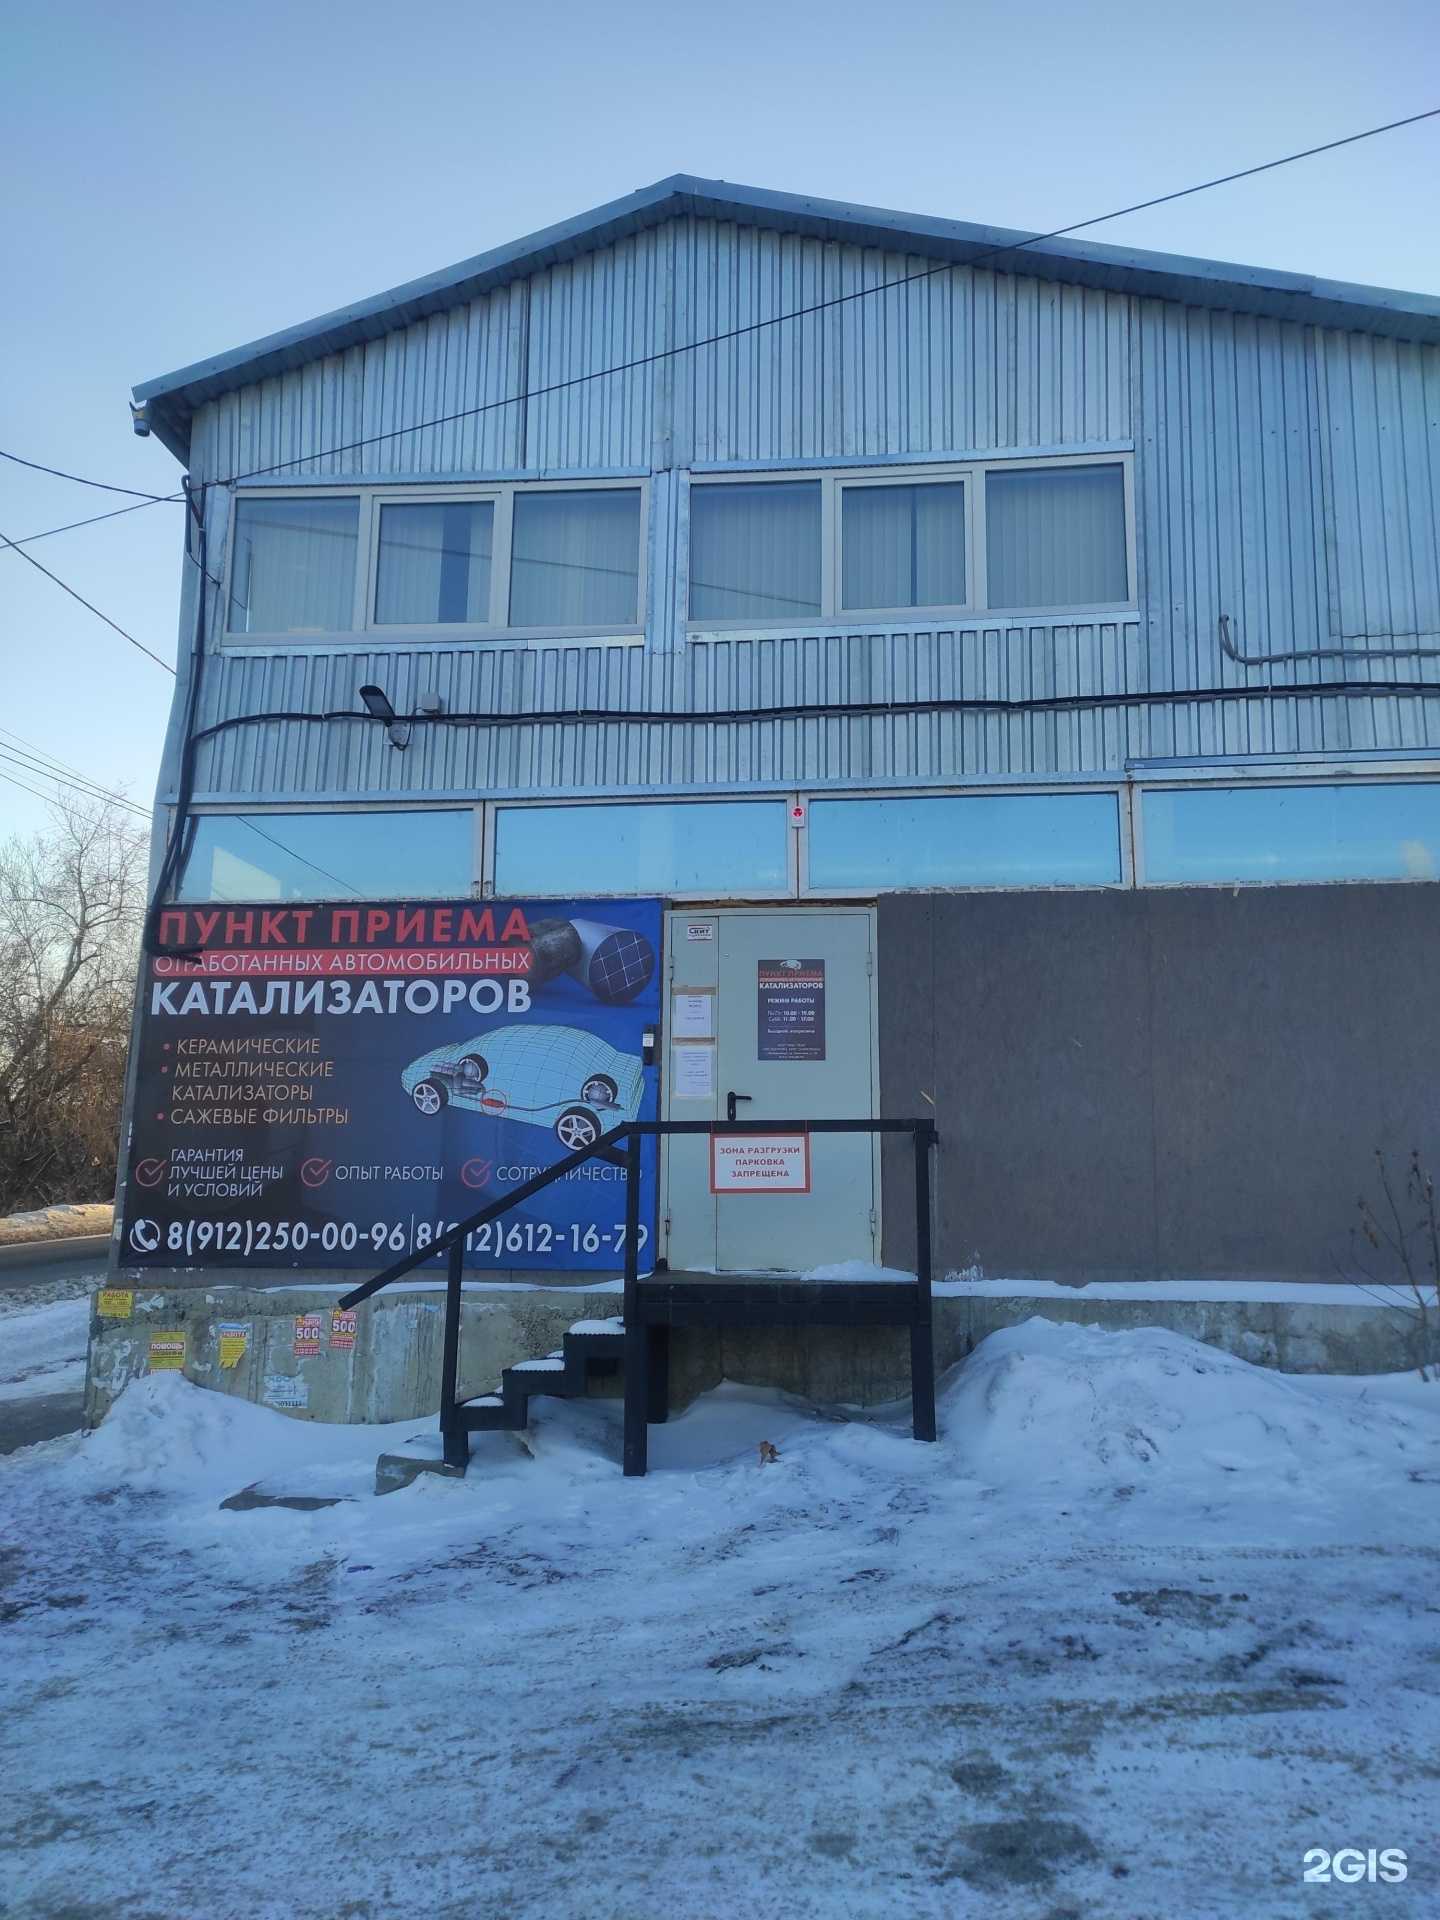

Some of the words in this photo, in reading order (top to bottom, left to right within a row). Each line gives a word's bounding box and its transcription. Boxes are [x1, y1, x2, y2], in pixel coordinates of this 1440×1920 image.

[158, 910, 313, 945] ПУНКТ
[331, 907, 531, 943] ПРИЕМА
[155, 953, 323, 973] ОТРАБОТАННЫХ
[328, 952, 530, 971] АВТОМОБИЛЬНЫХ
[759, 982, 824, 990] КАТАЛИЗАТОРОВ
[151, 978, 532, 1016] КАТАЛИЗАТОРОВ
[176, 1038, 321, 1055] КЕРАМИЧЕСКИЕ
[174, 1061, 335, 1078] МЕТАЛЛИЧЕСКИЕ
[172, 1085, 313, 1101] КАТАЛИЗАТОРЫ
[170, 1108, 257, 1125] САЖЕВЫЕ
[262, 1107, 349, 1124] ФИЛЬТРЫ
[170, 1148, 245, 1162] ГАРАНТИЯ
[719, 1146, 745, 1154] ЗОНА
[747, 1146, 801, 1154] РАЗГРУЗКИ
[735, 1158, 785, 1166] ПАРКОВКА
[168, 1163, 237, 1180] ЛУЧШЕЙ
[241, 1166, 284, 1181] ЦЕНЫ
[335, 1165, 381, 1180] ОПЫТ
[384, 1165, 444, 1180] РАБОТЫ
[496, 1165, 643, 1183] СОТРУИЧЕСТВ
[731, 1170, 790, 1178] ЗАПРЕЩЕНА
[167, 1183, 180, 1197] И
[183, 1180, 263, 1197] УСЛОВИЙ
[167, 1219, 406, 1257] 8(912)250-00-96
[416, 1220, 649, 1258] 8(12)612-16-79
[296, 1327, 319, 1339] 500
[333, 1319, 356, 1333] 500
